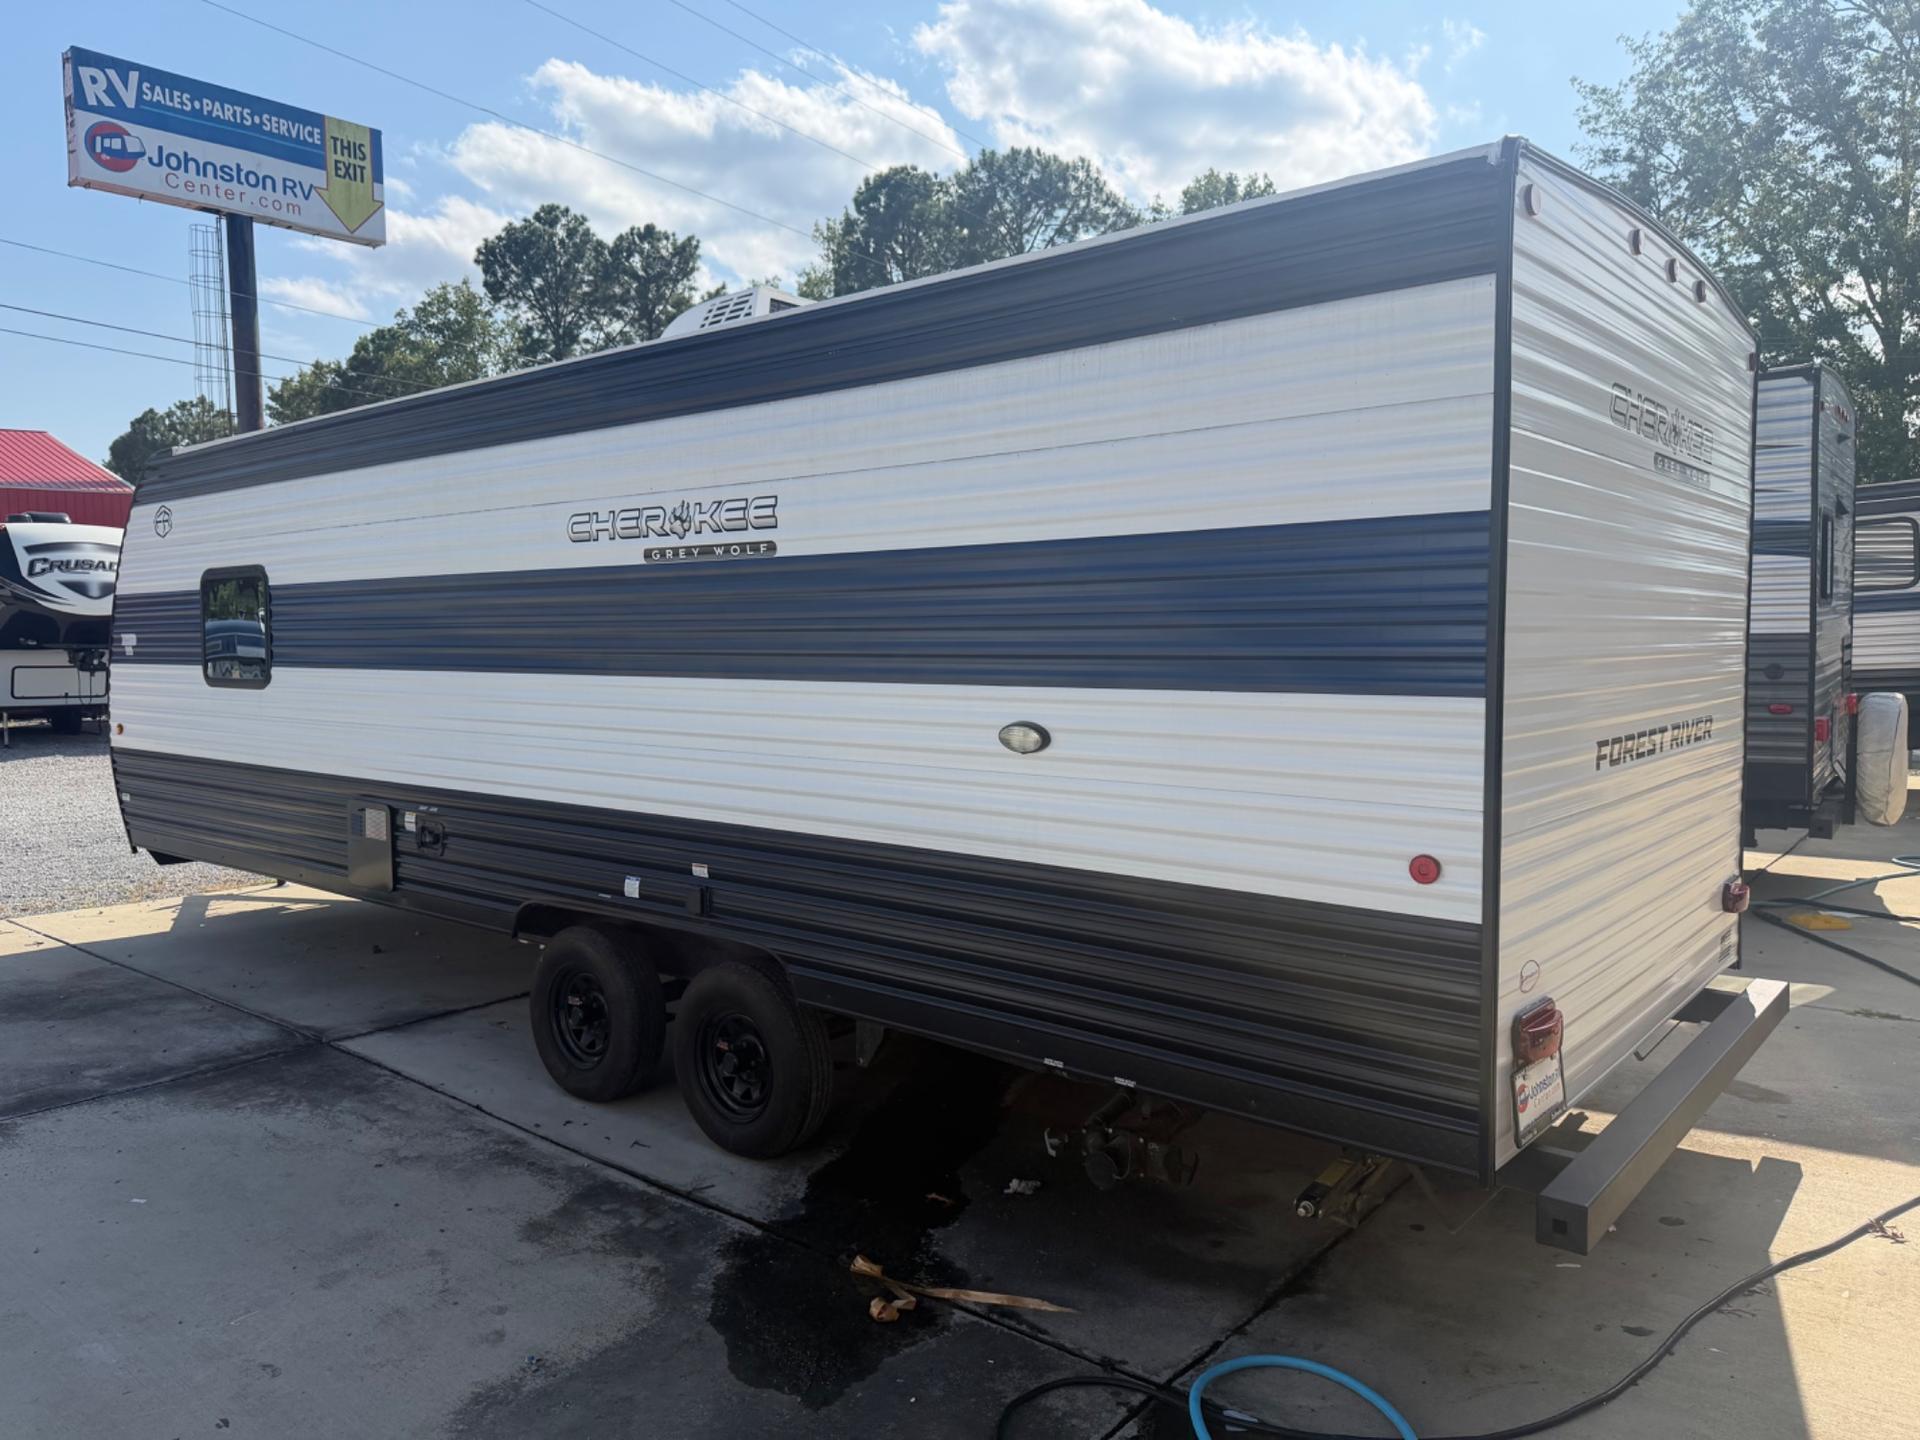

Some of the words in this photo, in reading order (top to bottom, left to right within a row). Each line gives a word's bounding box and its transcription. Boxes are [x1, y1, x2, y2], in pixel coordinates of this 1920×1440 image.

[78, 66, 139, 108] RV
[142, 82, 191, 112] SALES
[203, 98, 252, 126] PARTS
[262, 113, 322, 145] SERVICE
[330, 136, 367, 161] THIS
[148, 145, 277, 193] Johnston
[282, 177, 314, 201] RV
[334, 159, 367, 184] EXIT
[165, 172, 302, 216] Center.com
[651, 548, 700, 561] GREY
[713, 543, 769, 556] WOLF
[1596, 725, 1668, 771] FOREST
[1670, 715, 1713, 750] RIVER
